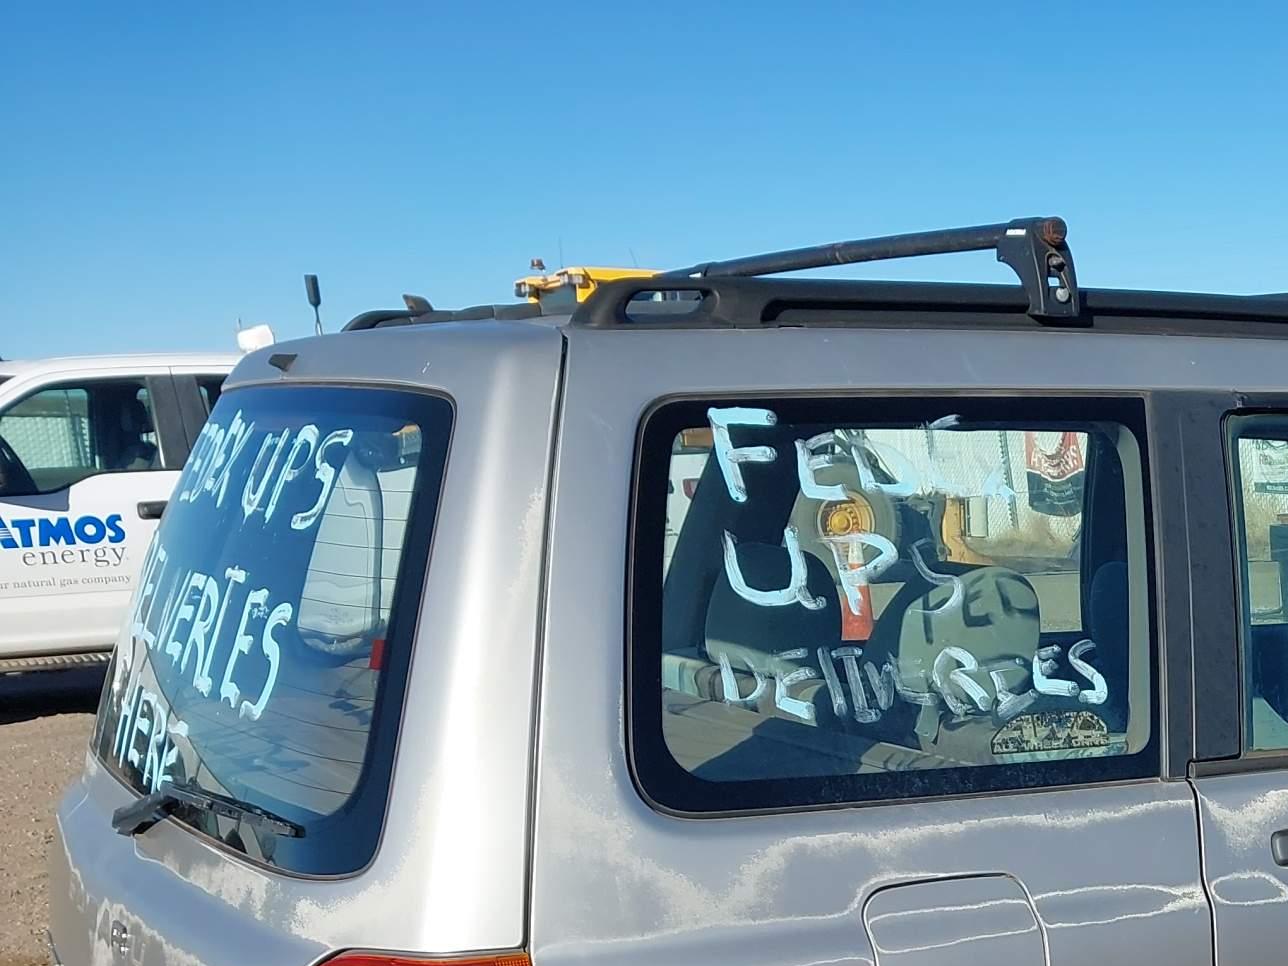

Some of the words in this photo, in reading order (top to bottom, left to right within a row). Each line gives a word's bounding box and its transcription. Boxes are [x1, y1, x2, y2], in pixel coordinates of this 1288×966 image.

[241, 424, 353, 530] UPS
[13, 577, 56, 589] natural
[60, 578, 79, 589] gas
[81, 574, 132, 585] company
[22, 545, 127, 568] energy
[112, 671, 189, 795] HERE
